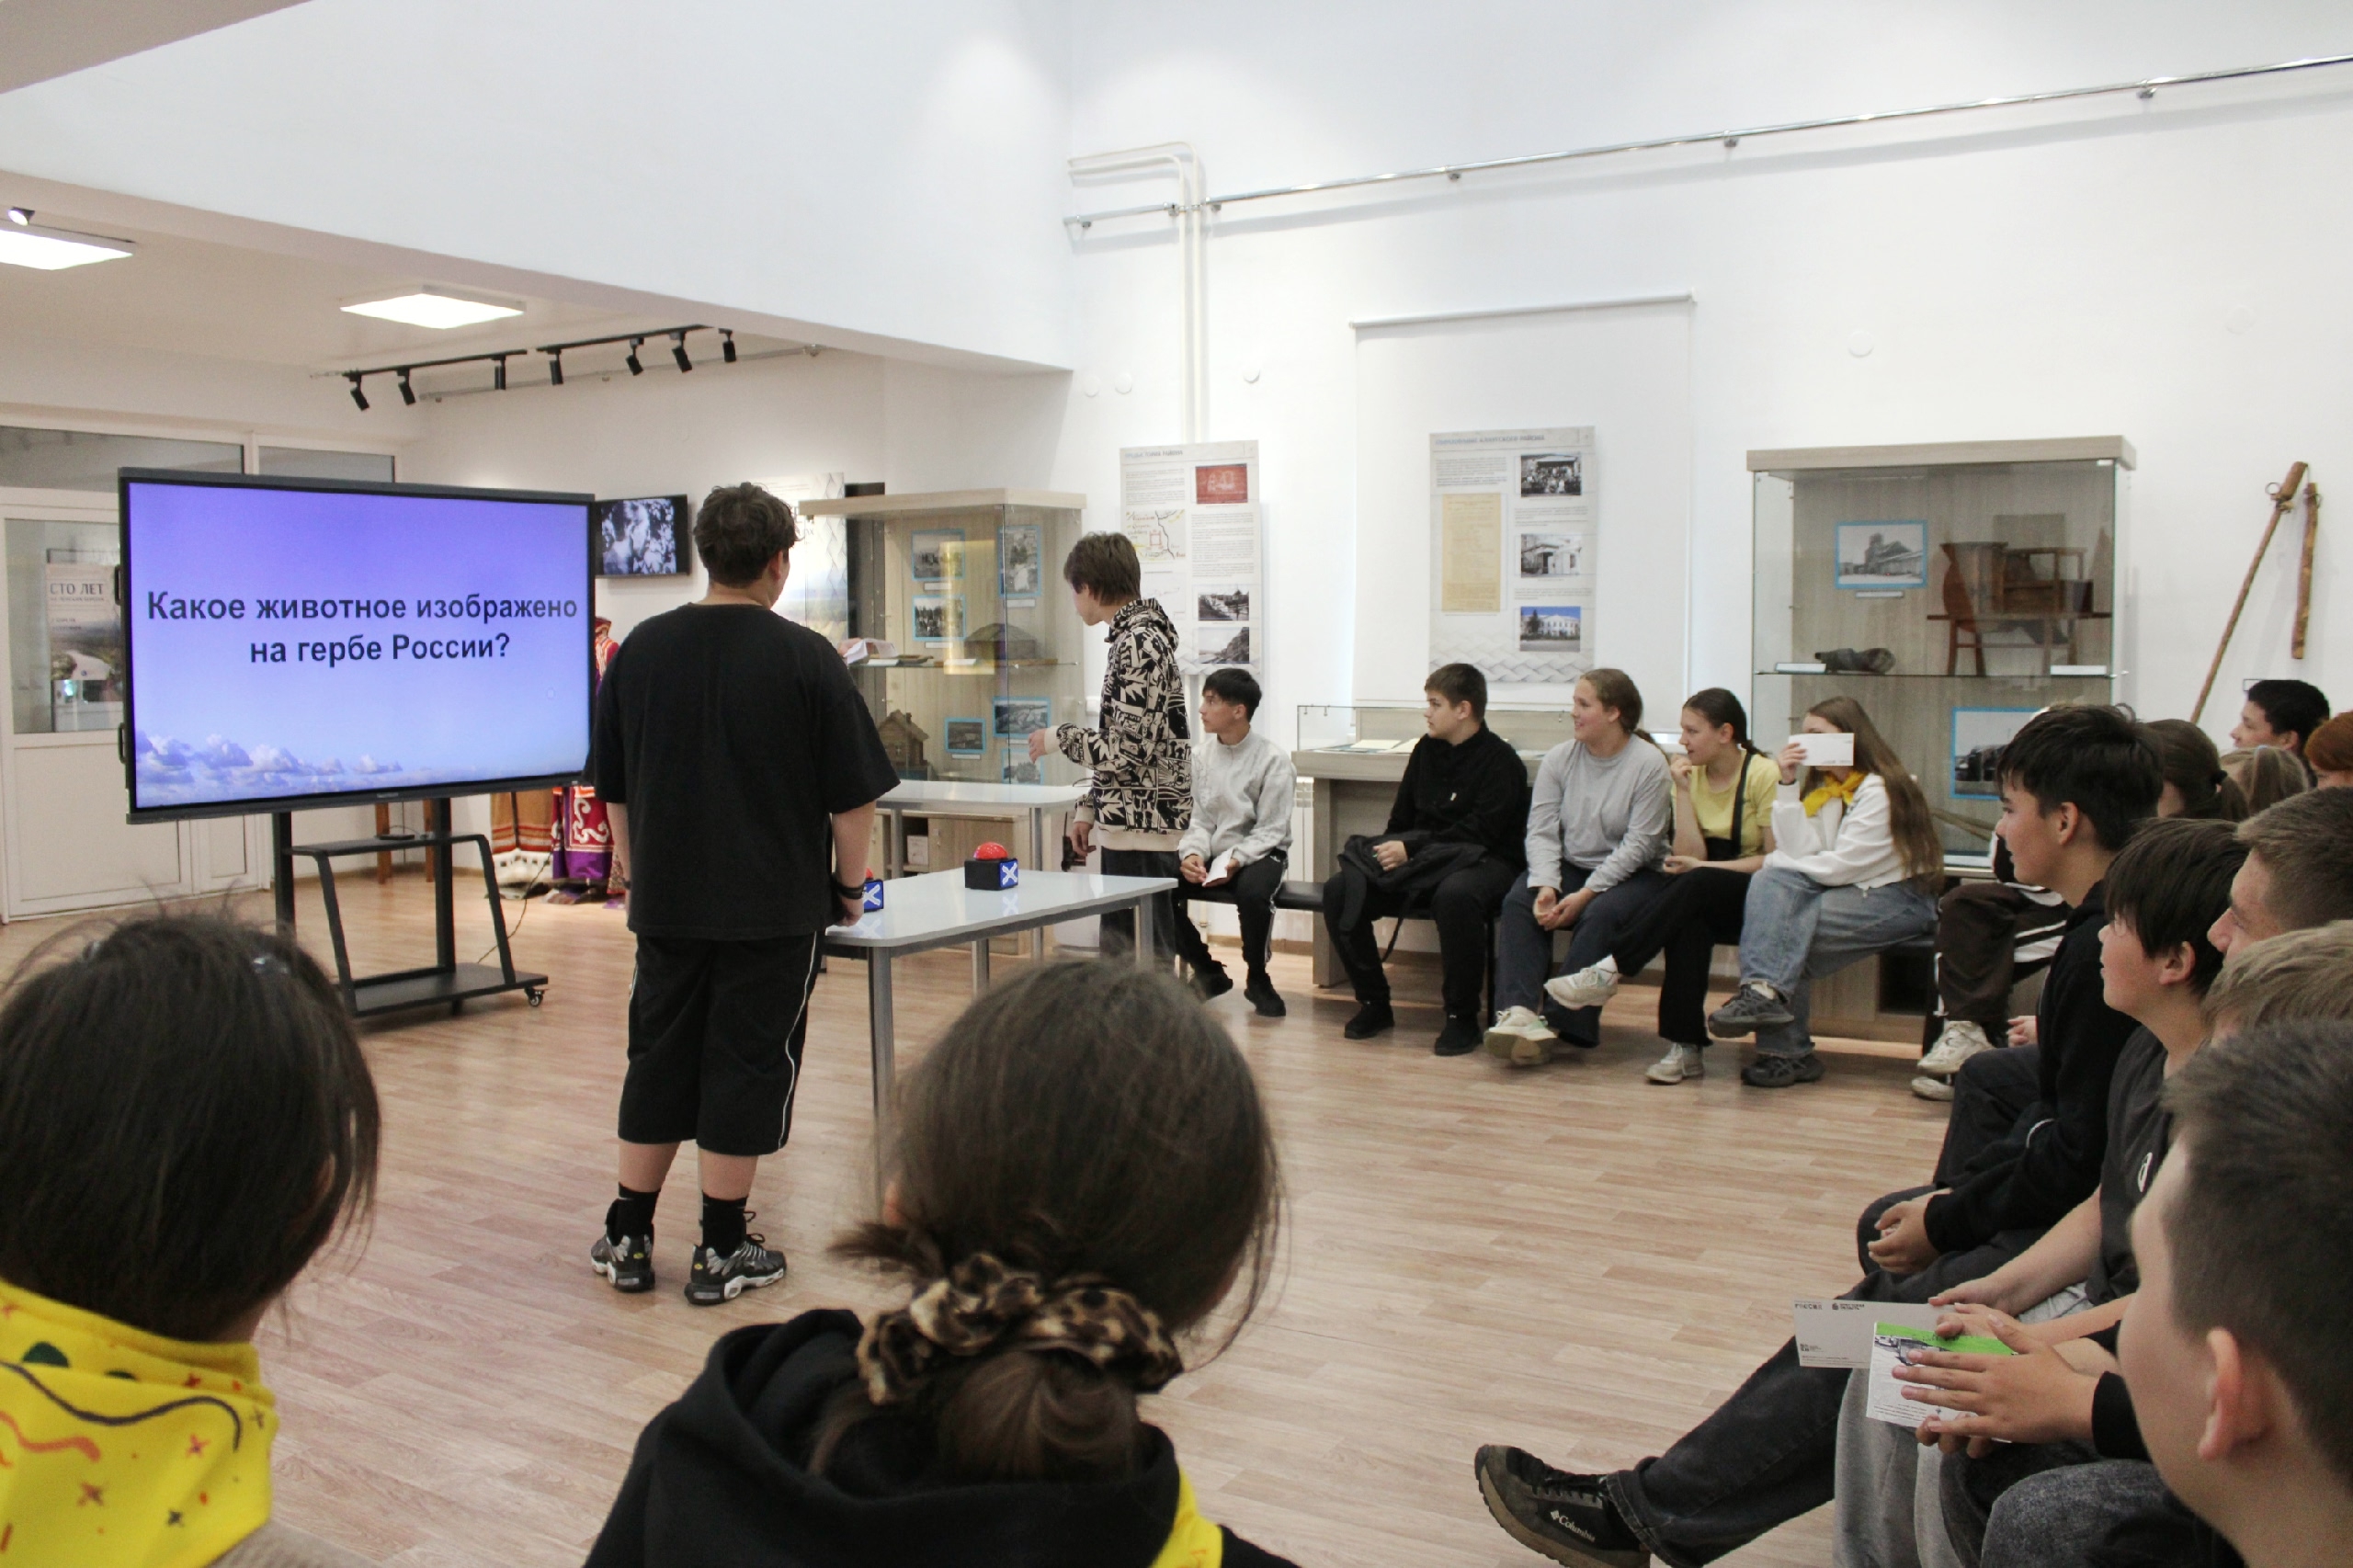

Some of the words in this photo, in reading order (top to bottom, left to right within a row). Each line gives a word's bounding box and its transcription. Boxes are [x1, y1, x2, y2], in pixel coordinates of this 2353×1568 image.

[80, 583, 103, 595] ЛЕТ
[148, 591, 245, 619] Какое
[256, 599, 406, 619] животное
[416, 593, 577, 624] изображено
[250, 642, 286, 663] на
[298, 634, 381, 668] гербе
[392, 632, 510, 660] России?
